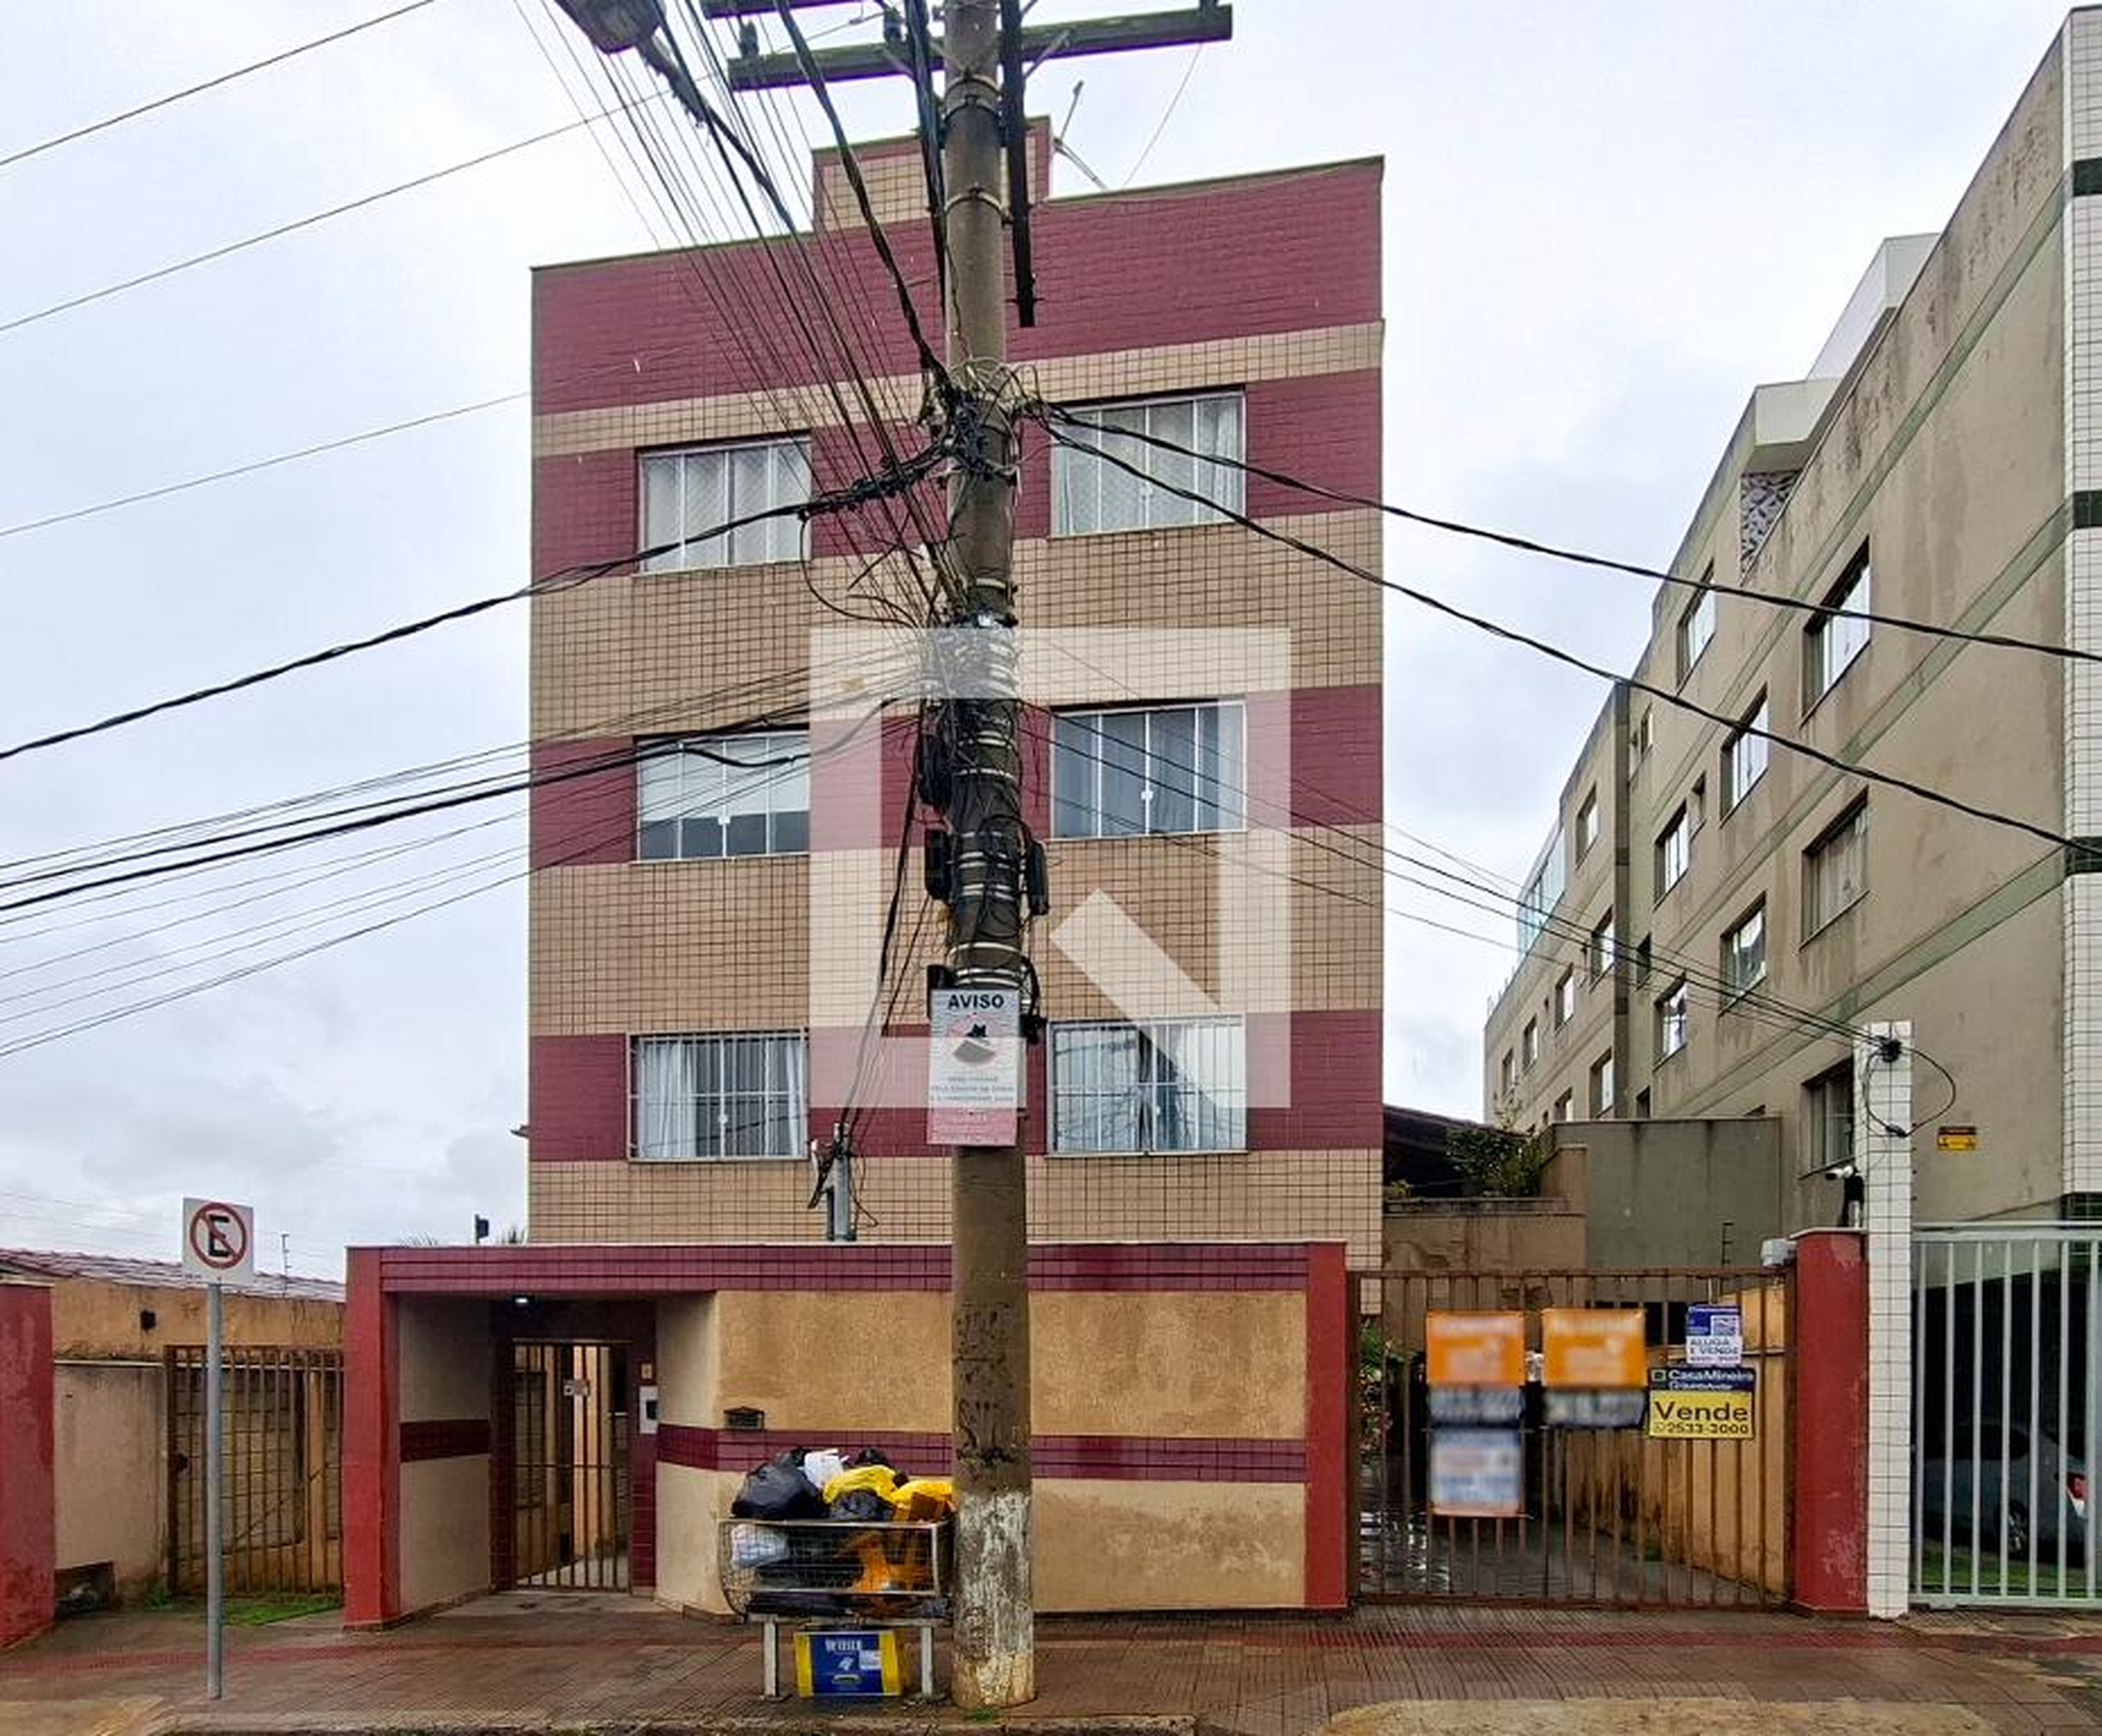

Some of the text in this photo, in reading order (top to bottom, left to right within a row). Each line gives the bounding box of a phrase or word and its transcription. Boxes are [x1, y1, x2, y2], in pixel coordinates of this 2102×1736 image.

[948, 994, 1004, 1009] AVISO
[209, 1214, 230, 1258] E
[1654, 1401, 1749, 1422] Vende
